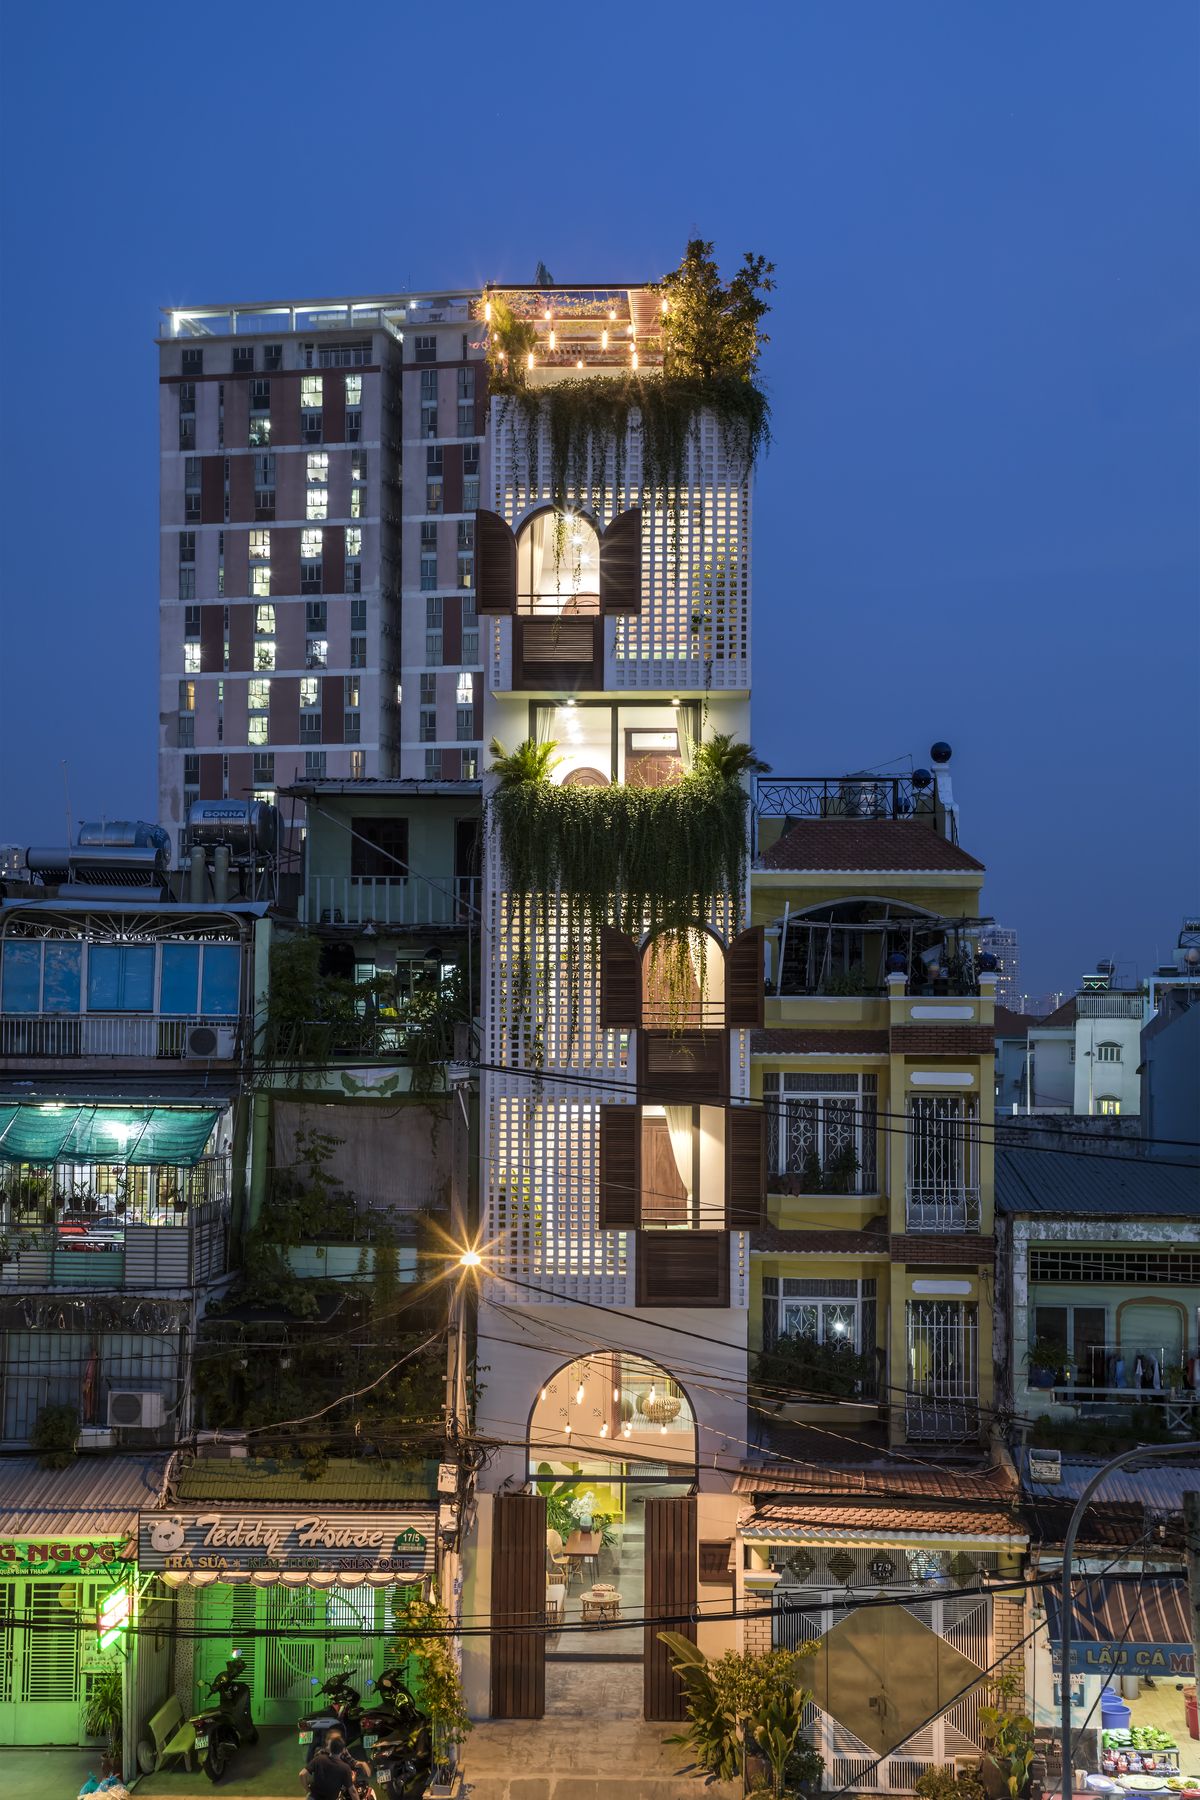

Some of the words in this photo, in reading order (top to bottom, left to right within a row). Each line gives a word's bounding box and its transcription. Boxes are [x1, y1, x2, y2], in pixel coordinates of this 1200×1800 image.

[196, 1514, 280, 1555] Teddy
[295, 1516, 384, 1548] House
[403, 1533, 420, 1542] 17/5
[27, 1543, 115, 1568] NGỌC
[199, 1554, 228, 1568] SỮA
[248, 1557, 280, 1568] KEM
[379, 1557, 411, 1571] QUE
[873, 1563, 891, 1571] 17/9
[1086, 1643, 1128, 1665] LẨU
[1136, 1648, 1166, 1666] CÁ
